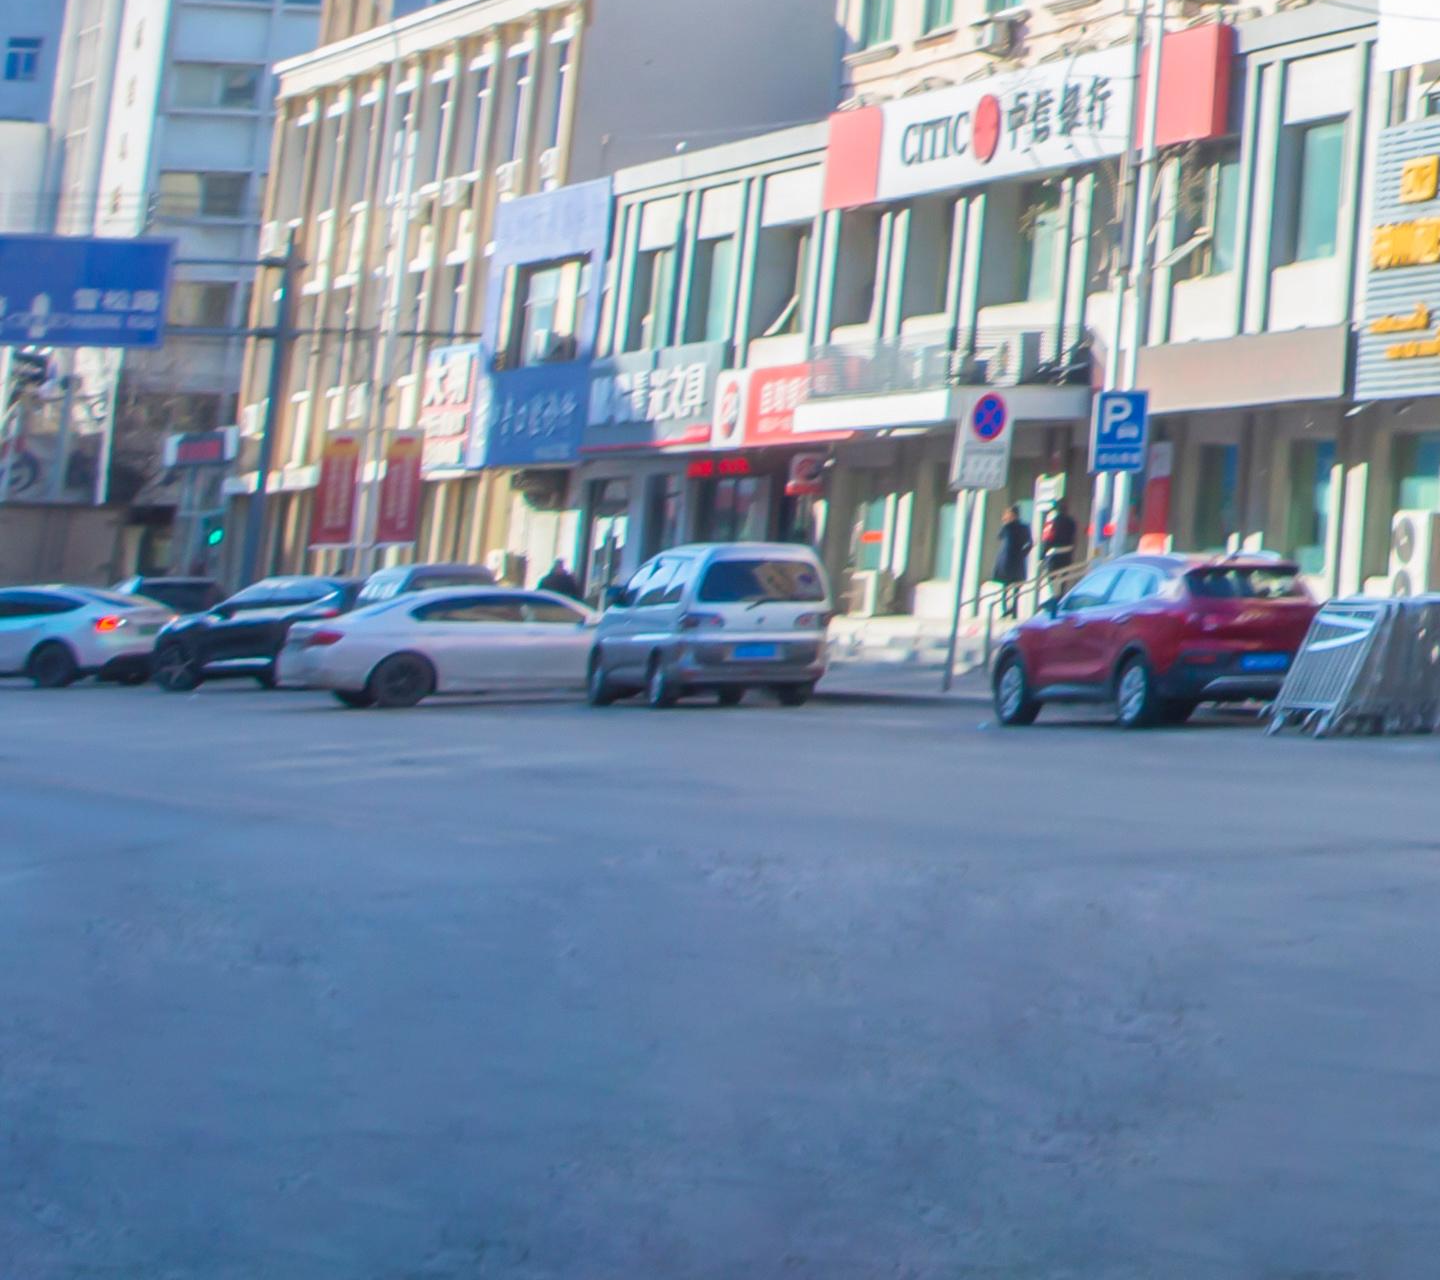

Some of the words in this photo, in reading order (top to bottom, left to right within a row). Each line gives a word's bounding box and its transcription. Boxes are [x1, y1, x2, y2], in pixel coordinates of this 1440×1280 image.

[901, 111, 971, 167] CITIC
[1006, 75, 1112, 151] 中信银行
[1102, 397, 1132, 435] P
